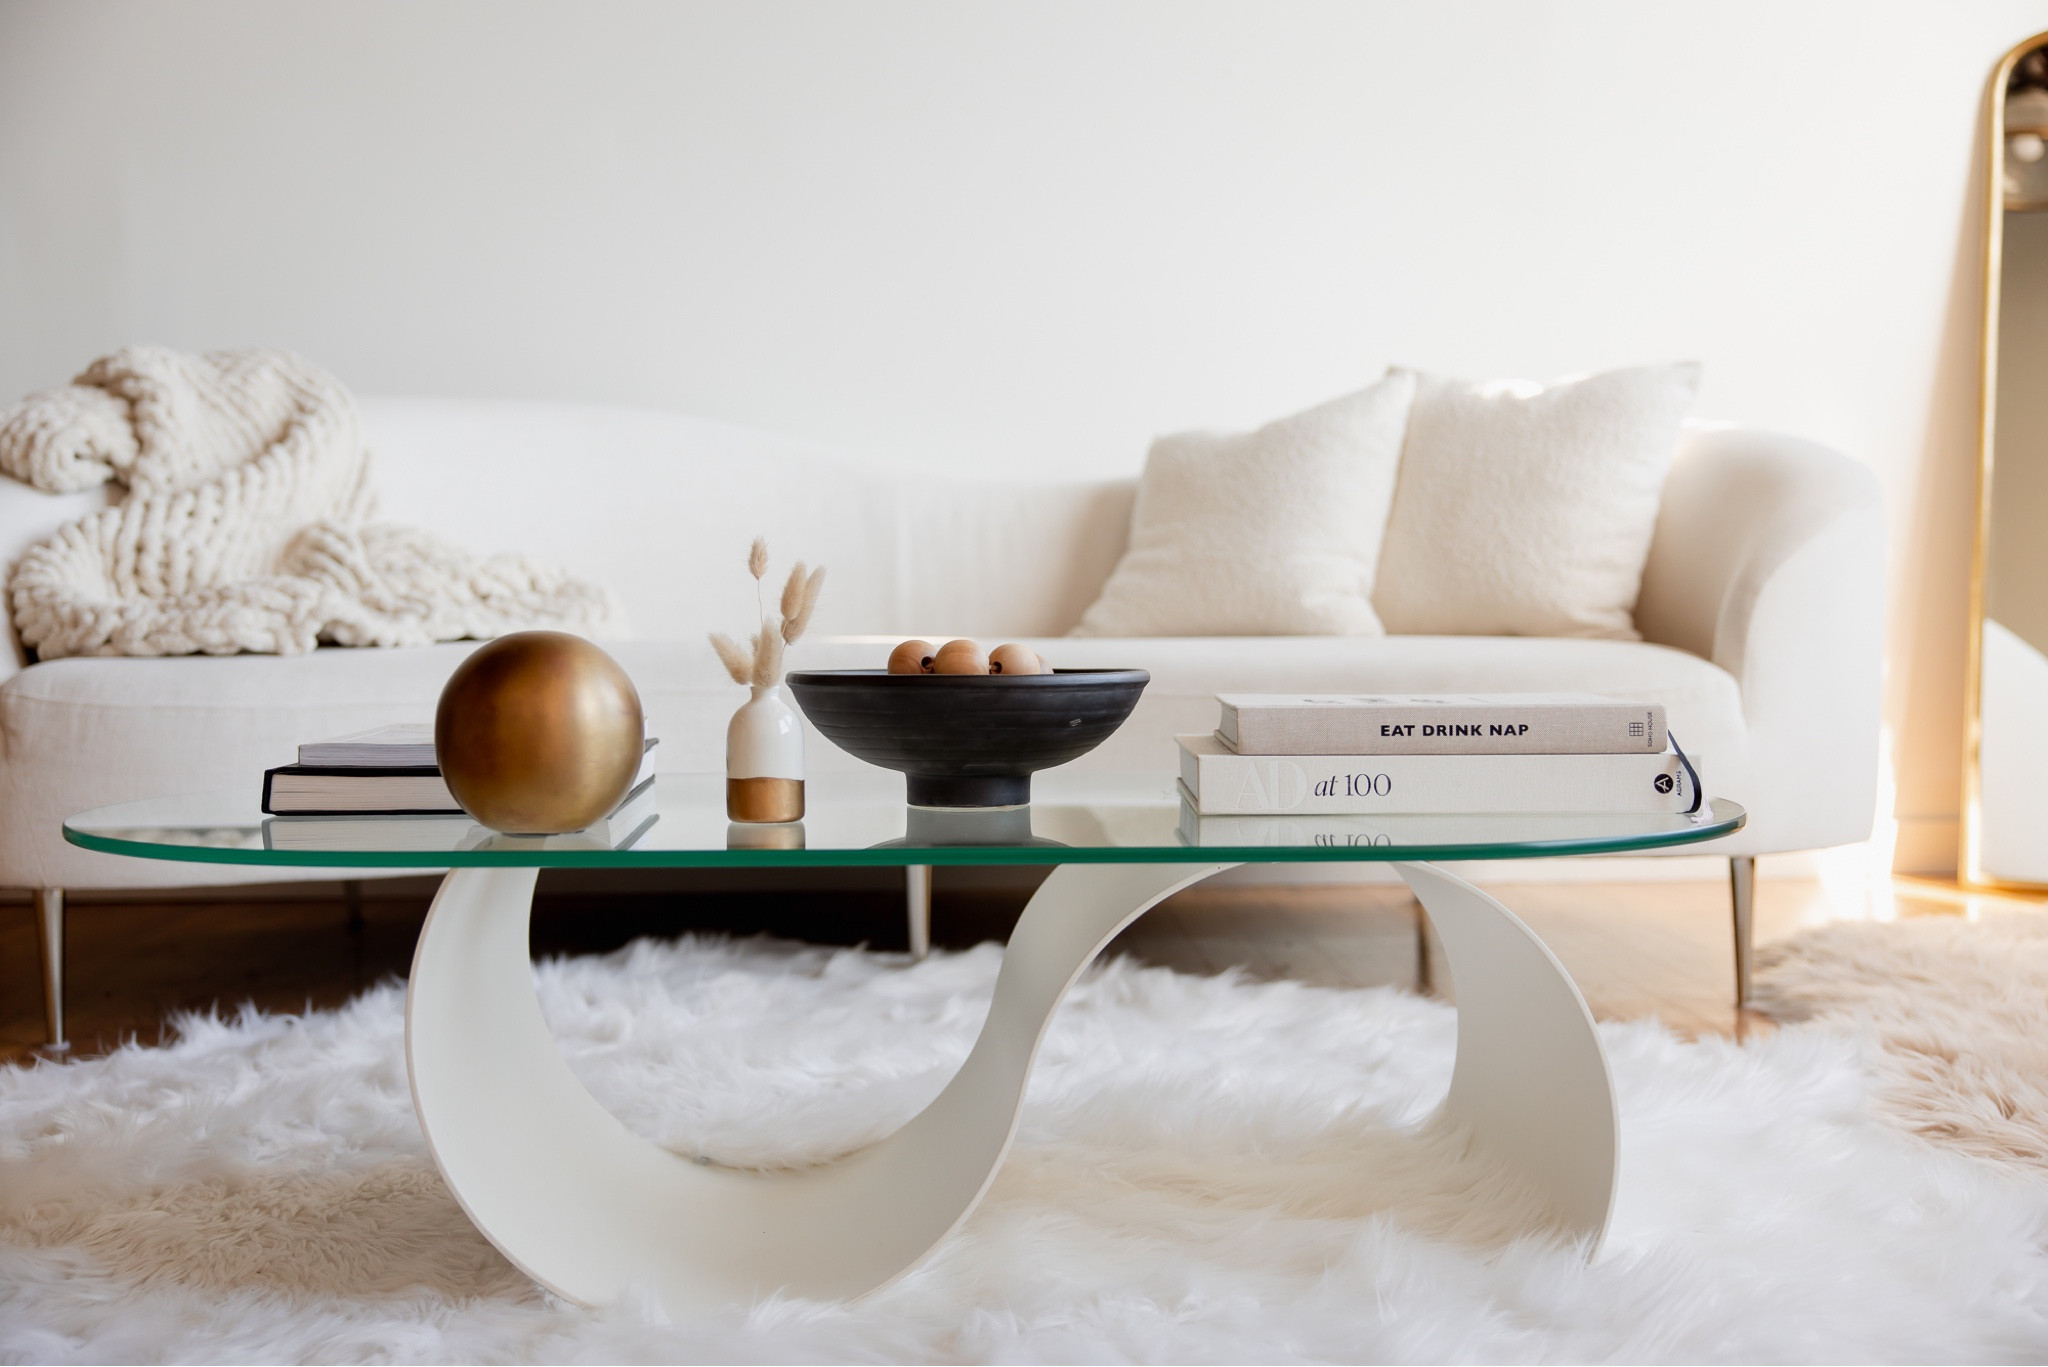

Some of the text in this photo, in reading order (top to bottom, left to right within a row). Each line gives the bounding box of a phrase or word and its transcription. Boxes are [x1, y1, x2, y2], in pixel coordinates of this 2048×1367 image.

[1380, 724, 1530, 737] EAT DRINK NAP
[1231, 760, 1392, 810] AD at 100
